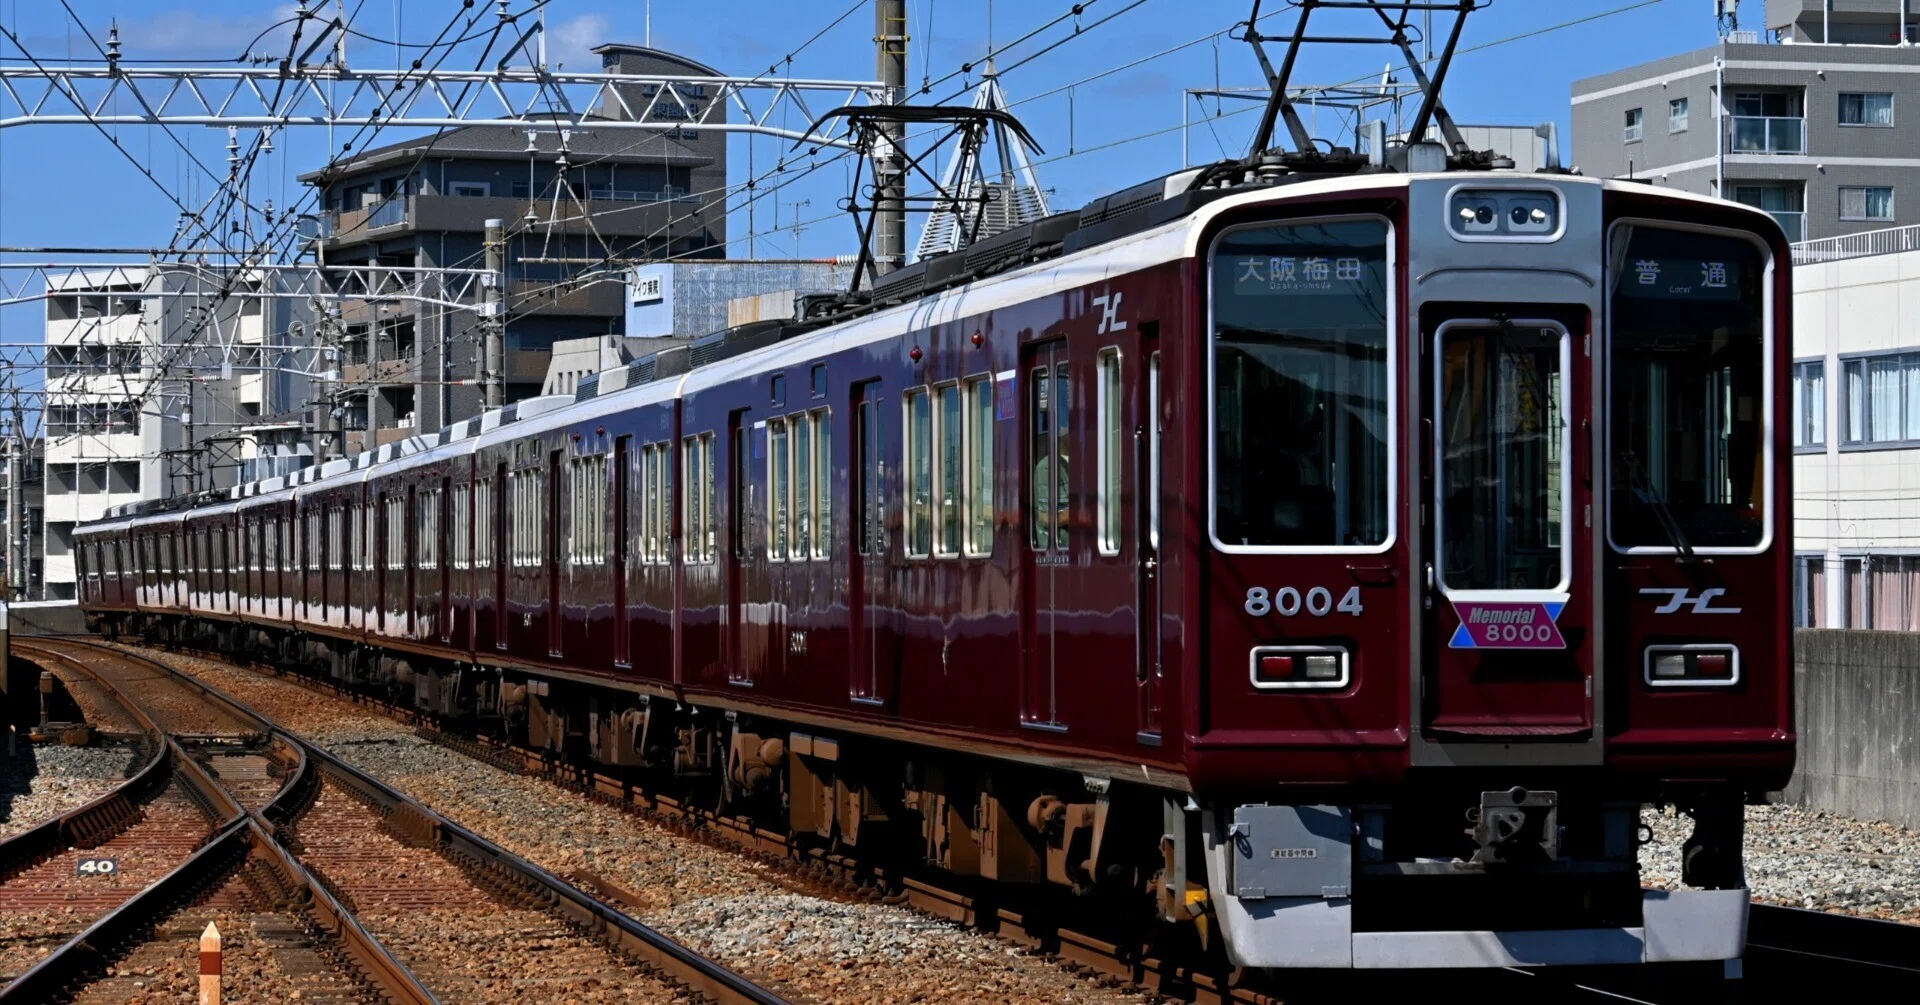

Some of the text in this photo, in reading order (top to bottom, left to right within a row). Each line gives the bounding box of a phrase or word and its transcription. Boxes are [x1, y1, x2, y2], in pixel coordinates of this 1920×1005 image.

[1238, 257, 1361, 282] 大阪梅田
[1635, 259, 1728, 288] 普通
[1244, 586, 1363, 617] 8004
[1468, 607, 1536, 624] Memorial
[1485, 624, 1552, 642] 8000
[79, 860, 114, 873] 40
